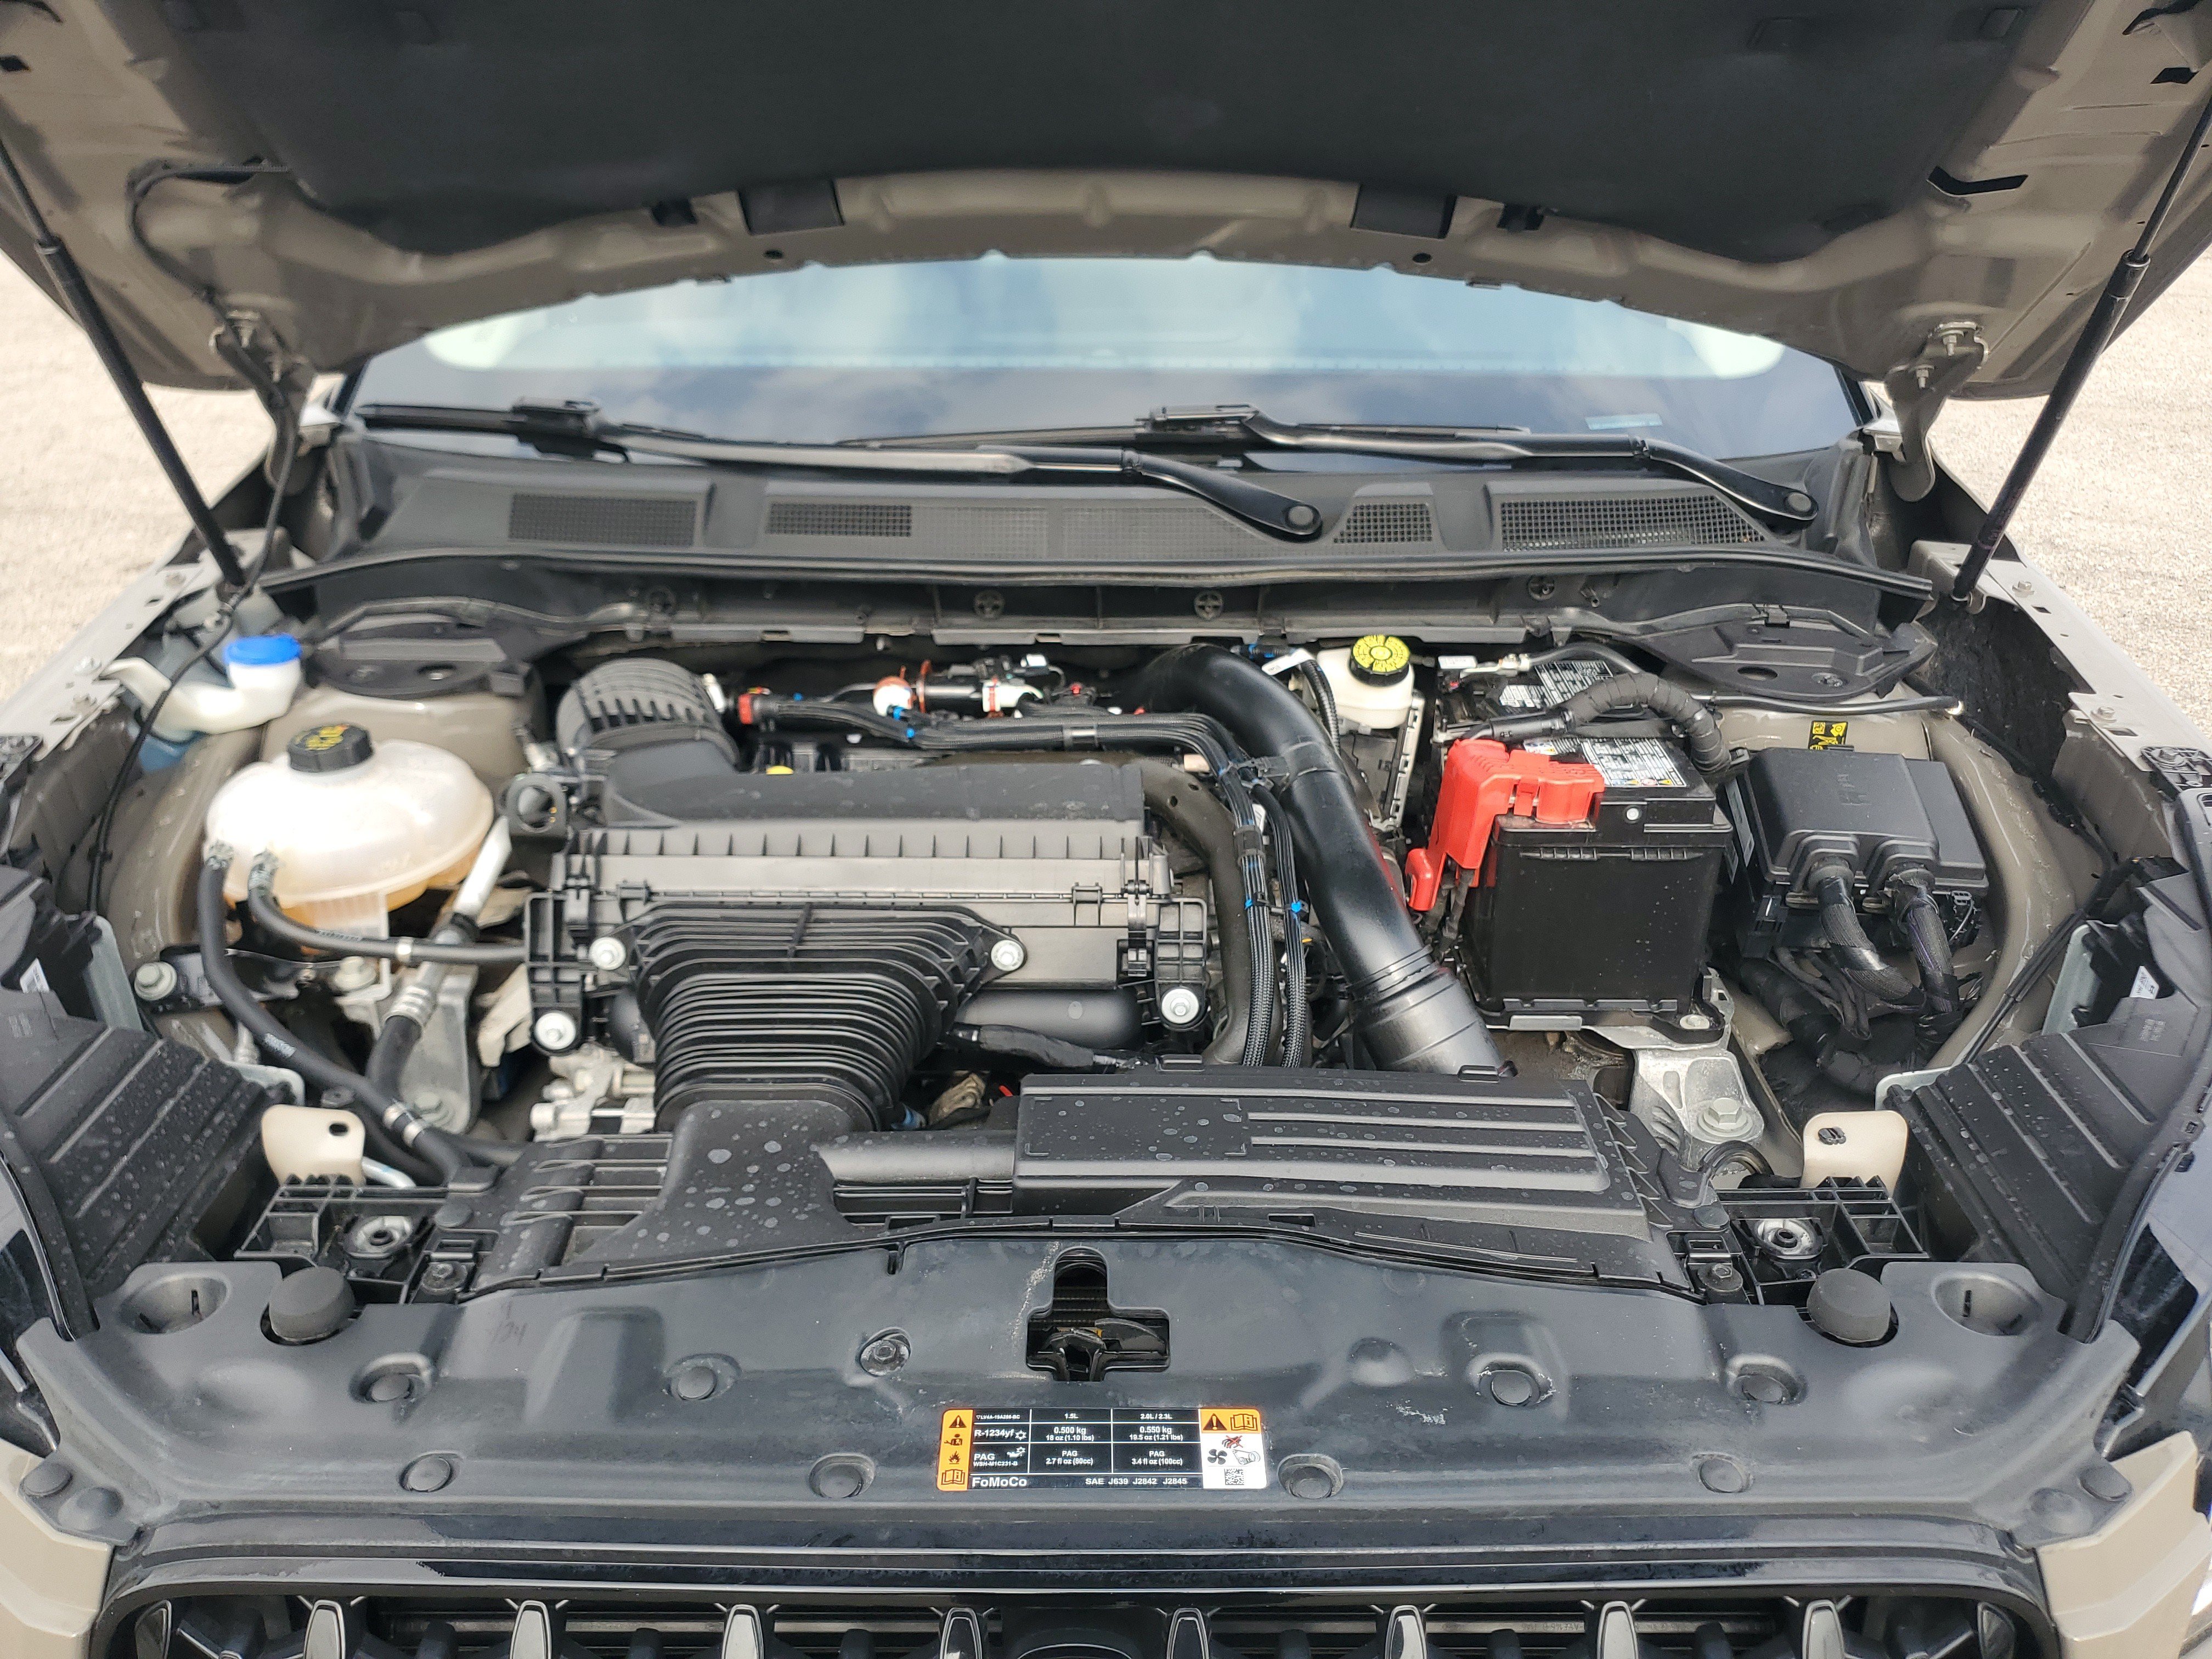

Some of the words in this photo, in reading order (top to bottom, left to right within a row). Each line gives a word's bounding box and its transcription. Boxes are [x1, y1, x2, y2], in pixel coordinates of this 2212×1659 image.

[974, 1429, 1014, 1437] R-1234yf
[1076, 1426, 1086, 1435] kg
[1162, 1426, 1172, 1434] kg
[972, 1477, 1027, 1487] FoMoCo
